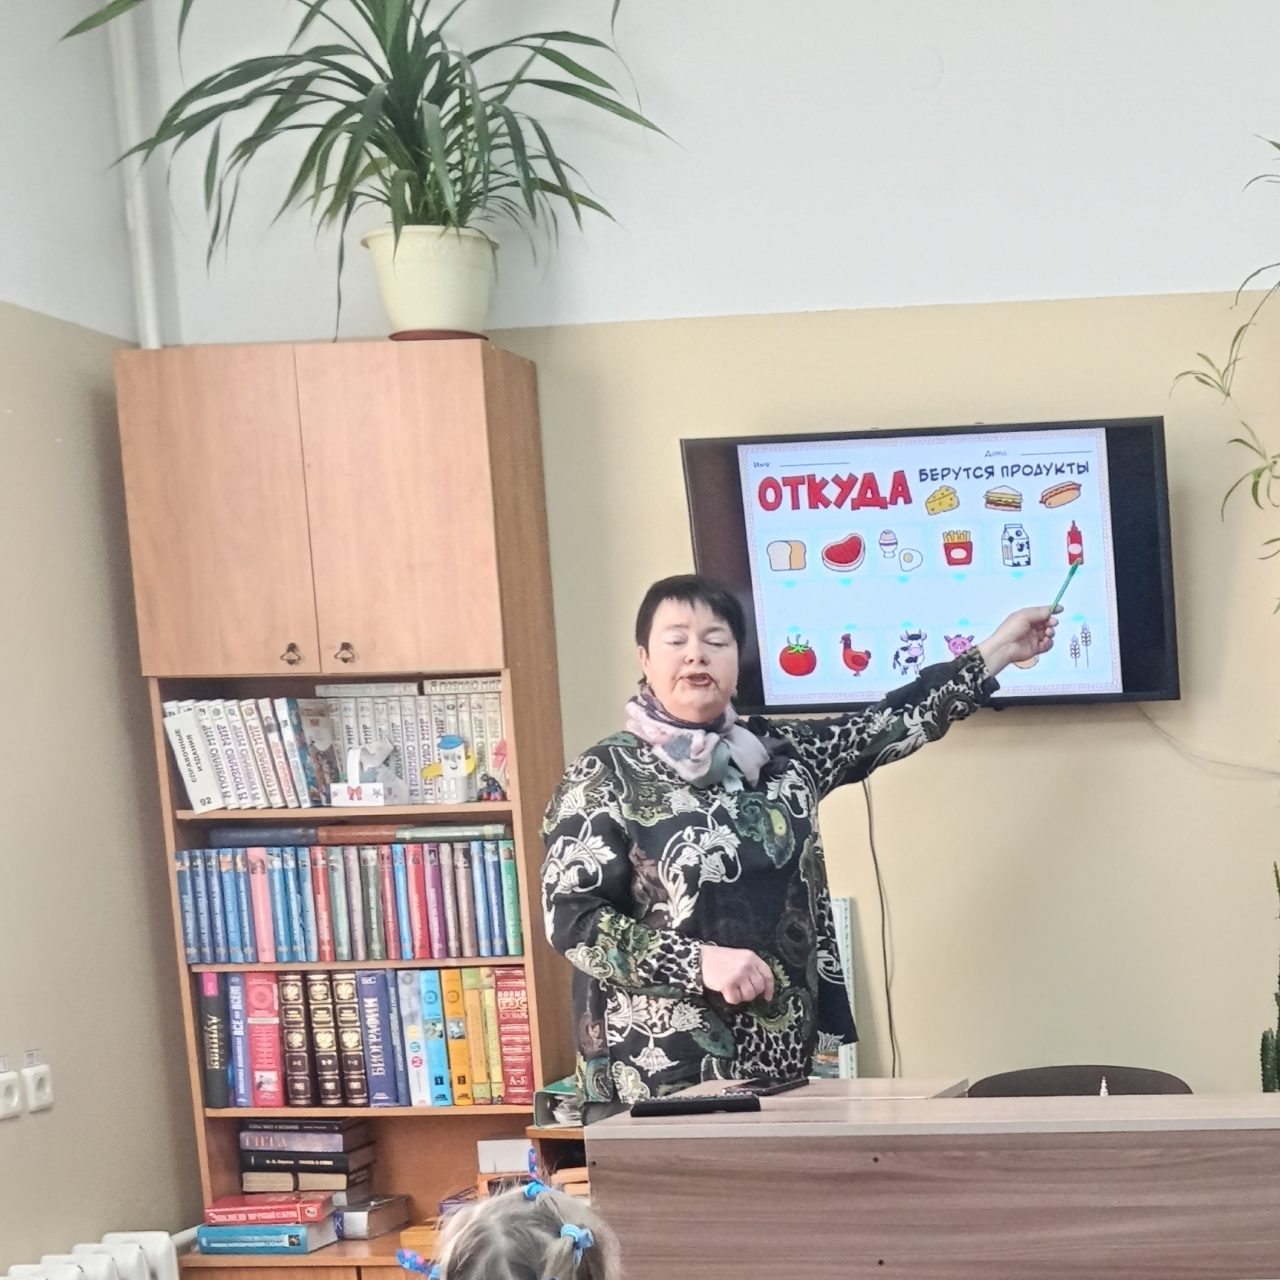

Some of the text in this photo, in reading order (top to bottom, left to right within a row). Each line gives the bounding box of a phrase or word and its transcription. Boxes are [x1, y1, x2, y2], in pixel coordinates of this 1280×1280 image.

[758, 460, 1090, 511] ОТКУДА БЕРУТСЯ ПРОДУКТЫ
[232, 724, 247, 747] МИР
[248, 724, 264, 746] МИР
[345, 724, 355, 745] МИР
[362, 724, 372, 745] МИР
[419, 718, 430, 741] МИР
[175, 728, 197, 783] СПРАВОЧНЫЕ
[186, 734, 203, 772] ИЗДАНИЯ
[202, 724, 232, 799] Я ПОЗНАЮ МИР
[216, 724, 248, 801] Я ПОЗНАЮ МИР
[404, 720, 420, 797] Я ПОЗНАЮ МИР
[363, 997, 386, 1077] БИОГРАФИИ
